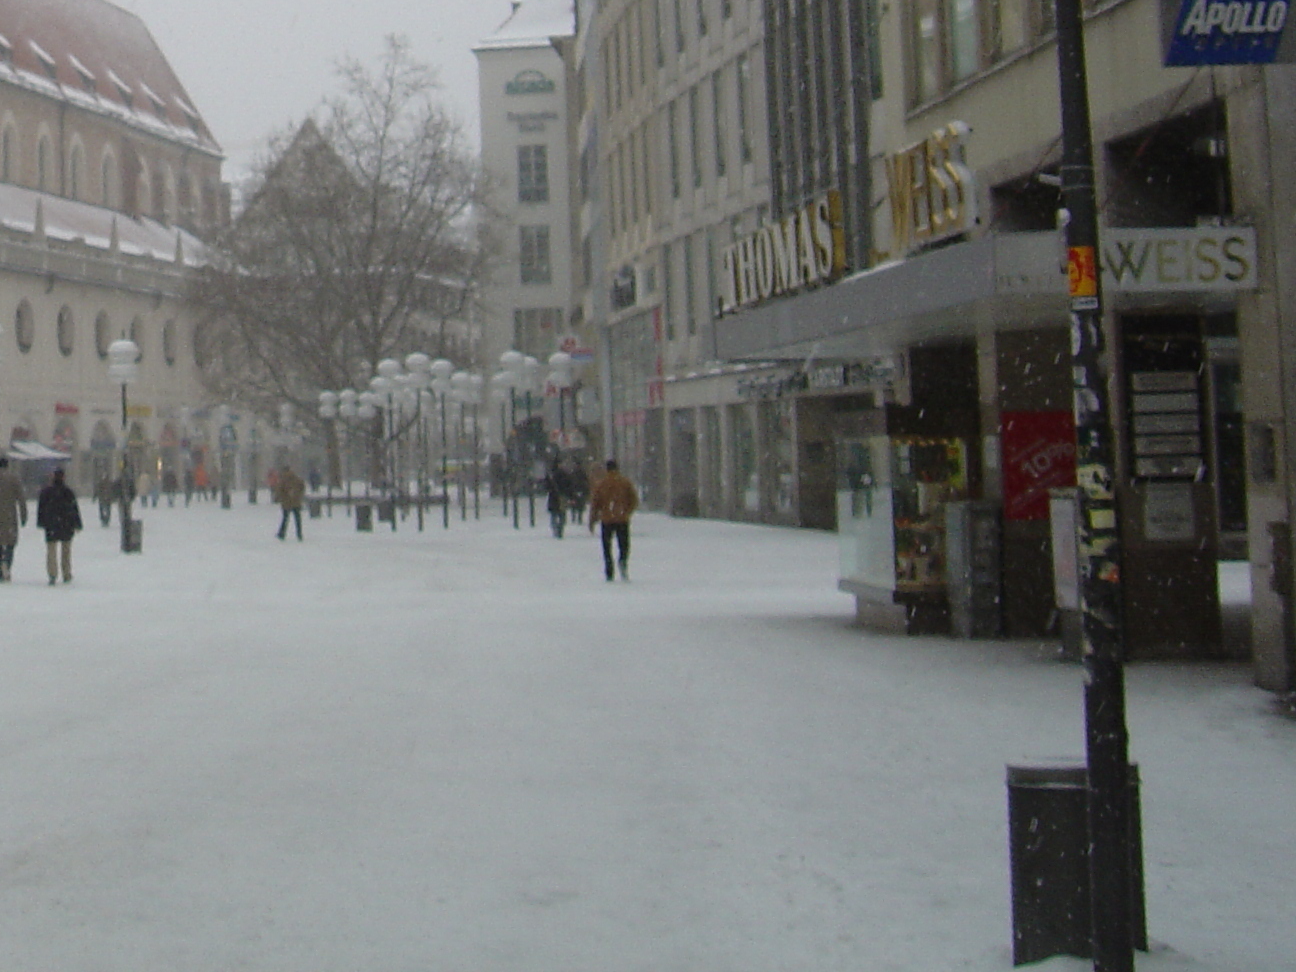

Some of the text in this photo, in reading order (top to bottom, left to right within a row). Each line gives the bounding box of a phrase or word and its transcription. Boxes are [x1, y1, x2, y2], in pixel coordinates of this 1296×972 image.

[720, 198, 840, 312] THOMAS
[1105, 236, 1249, 283] WEISS
[1021, 441, 1075, 478] 10%
